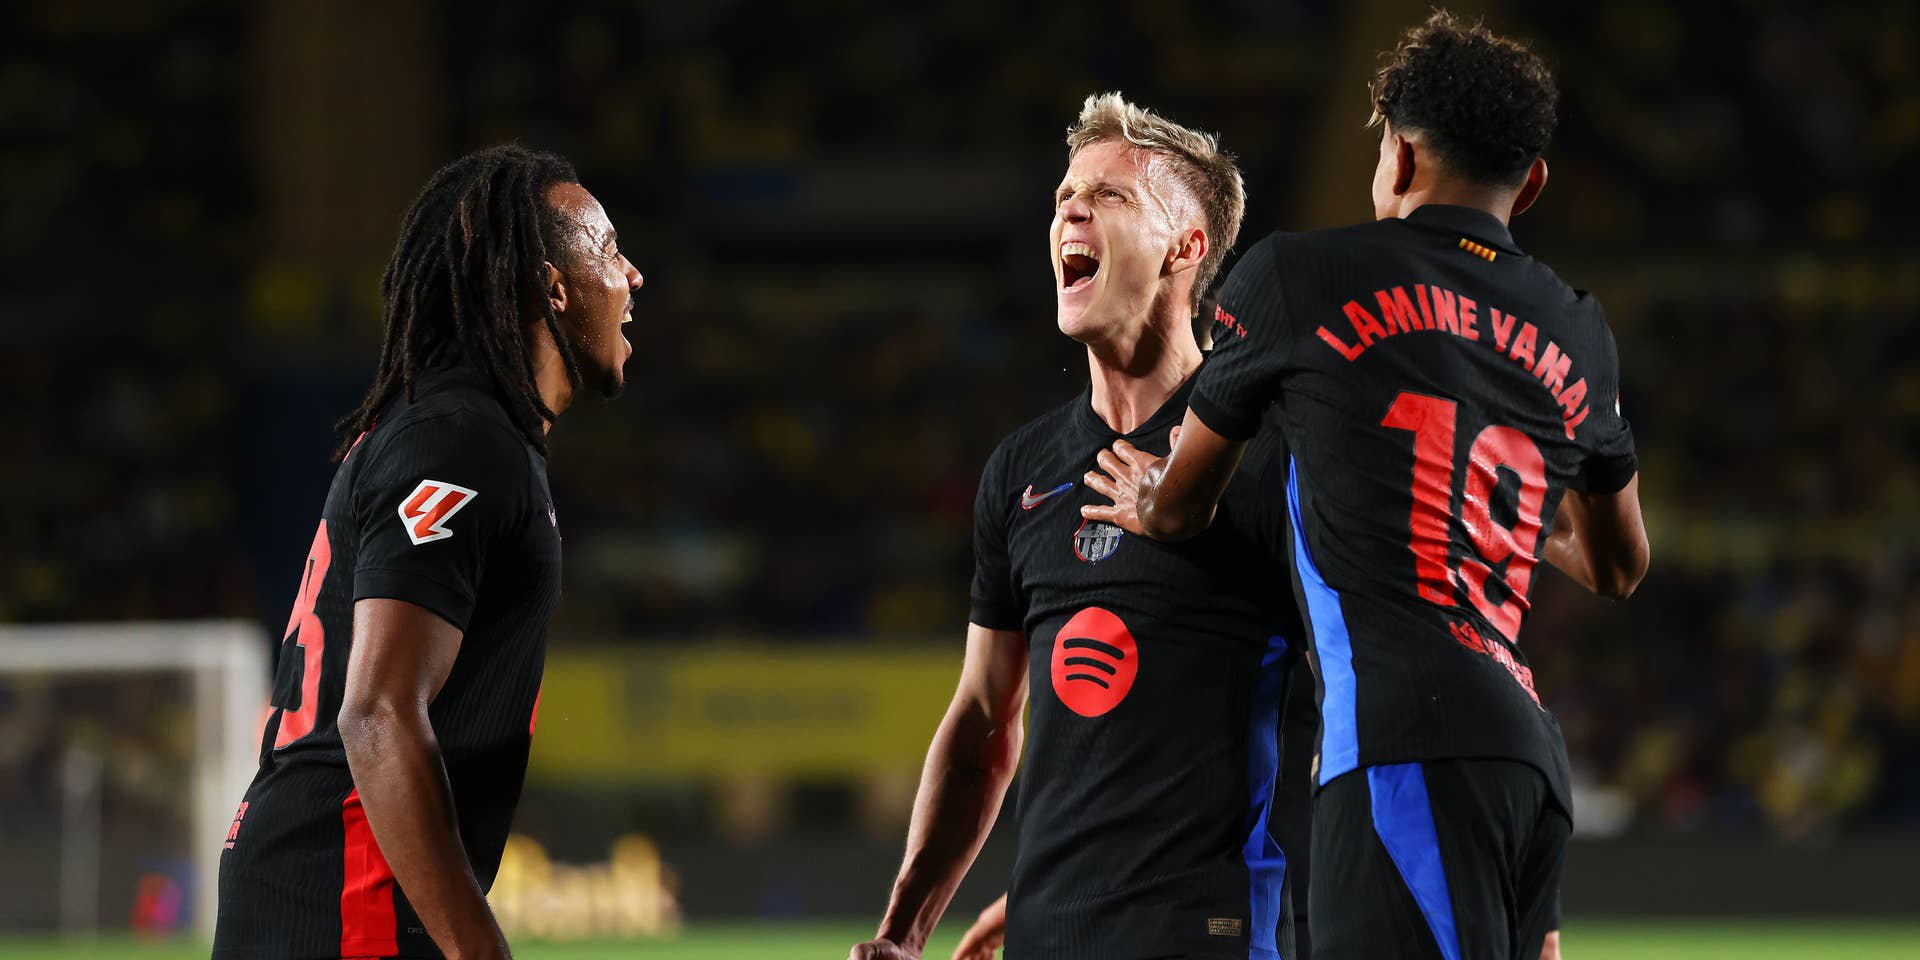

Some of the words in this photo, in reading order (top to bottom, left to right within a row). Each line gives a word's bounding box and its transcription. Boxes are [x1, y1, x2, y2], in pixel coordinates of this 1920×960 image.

[1316, 284, 1480, 362] LAMINE
[1490, 307, 1590, 441] YAMAL
[1380, 391, 1549, 644] 19
